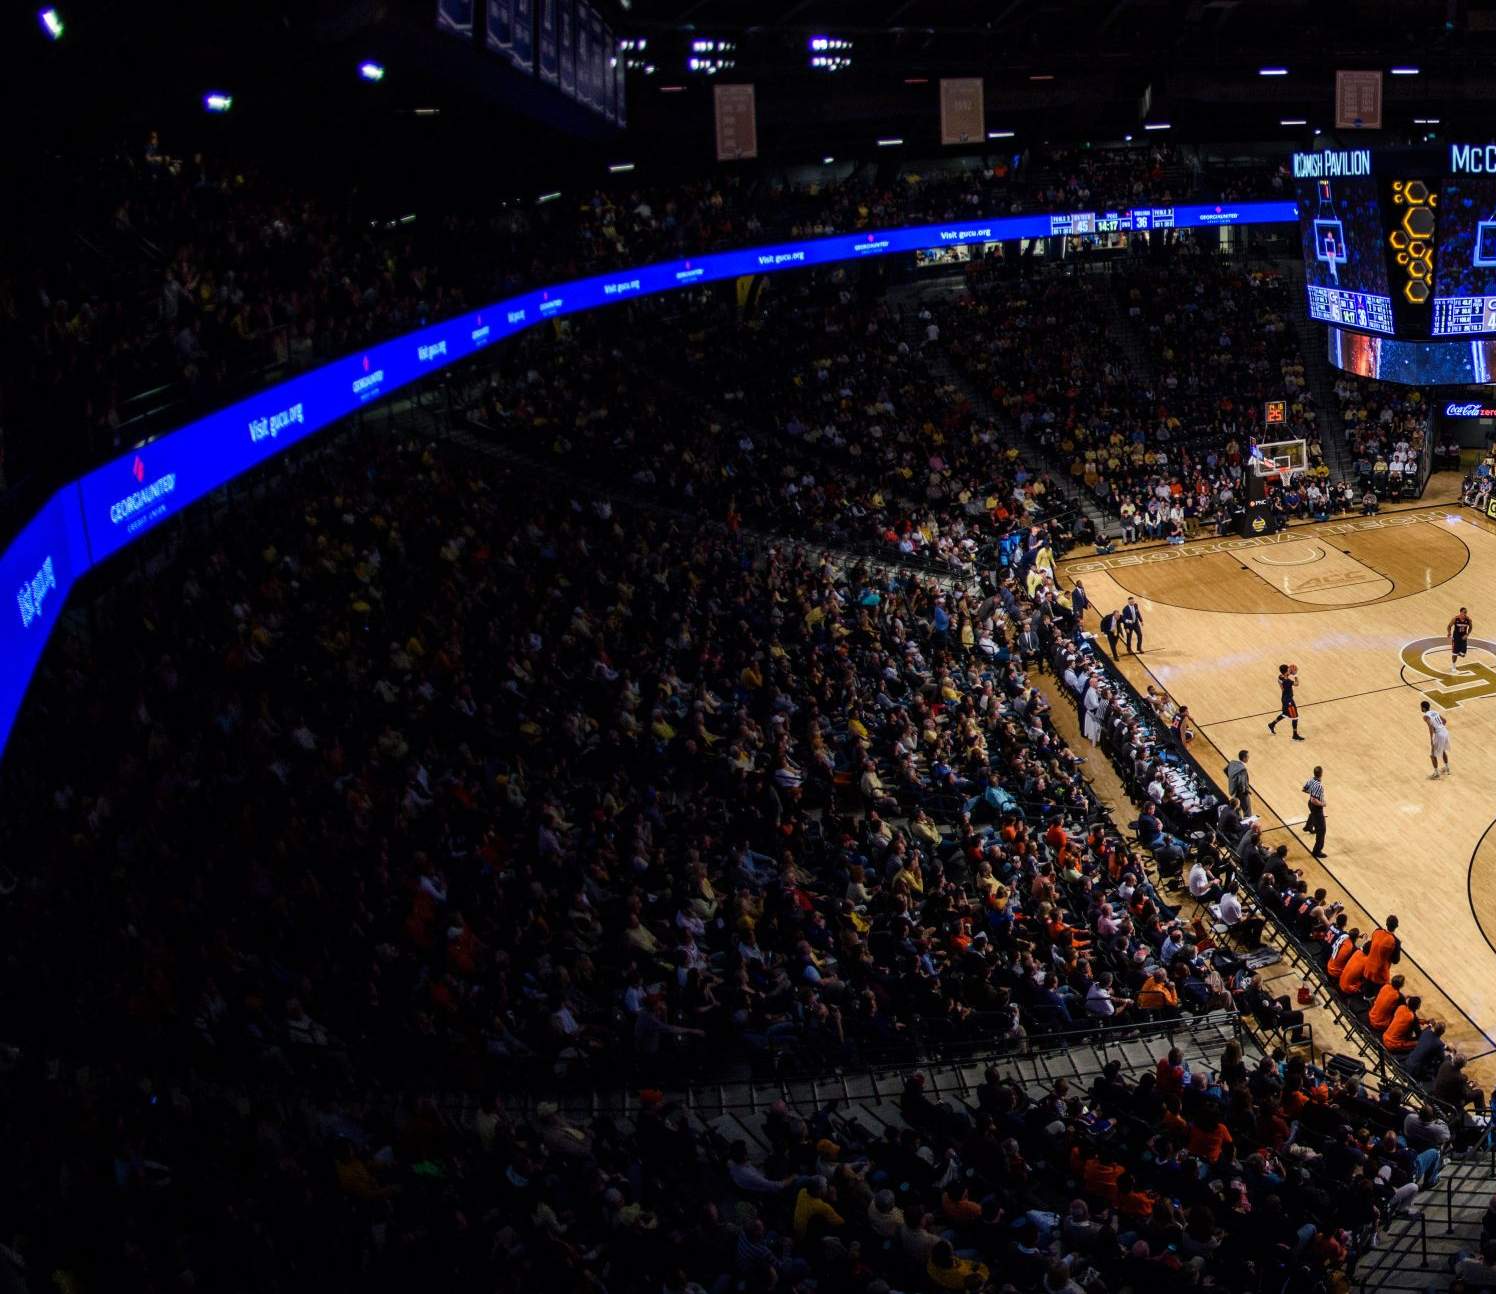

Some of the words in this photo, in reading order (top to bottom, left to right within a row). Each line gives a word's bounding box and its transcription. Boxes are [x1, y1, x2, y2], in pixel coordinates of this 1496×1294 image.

[1324, 150, 1370, 176] PAVILION
[1078, 221, 1088, 232] 45
[1098, 220, 1118, 232] 14:17
[1136, 217, 1148, 228] 36
[941, 231, 958, 240] Visit
[959, 228, 990, 240] gucu.org
[758, 255, 774, 265] Visit
[775, 251, 804, 264] gucu.org
